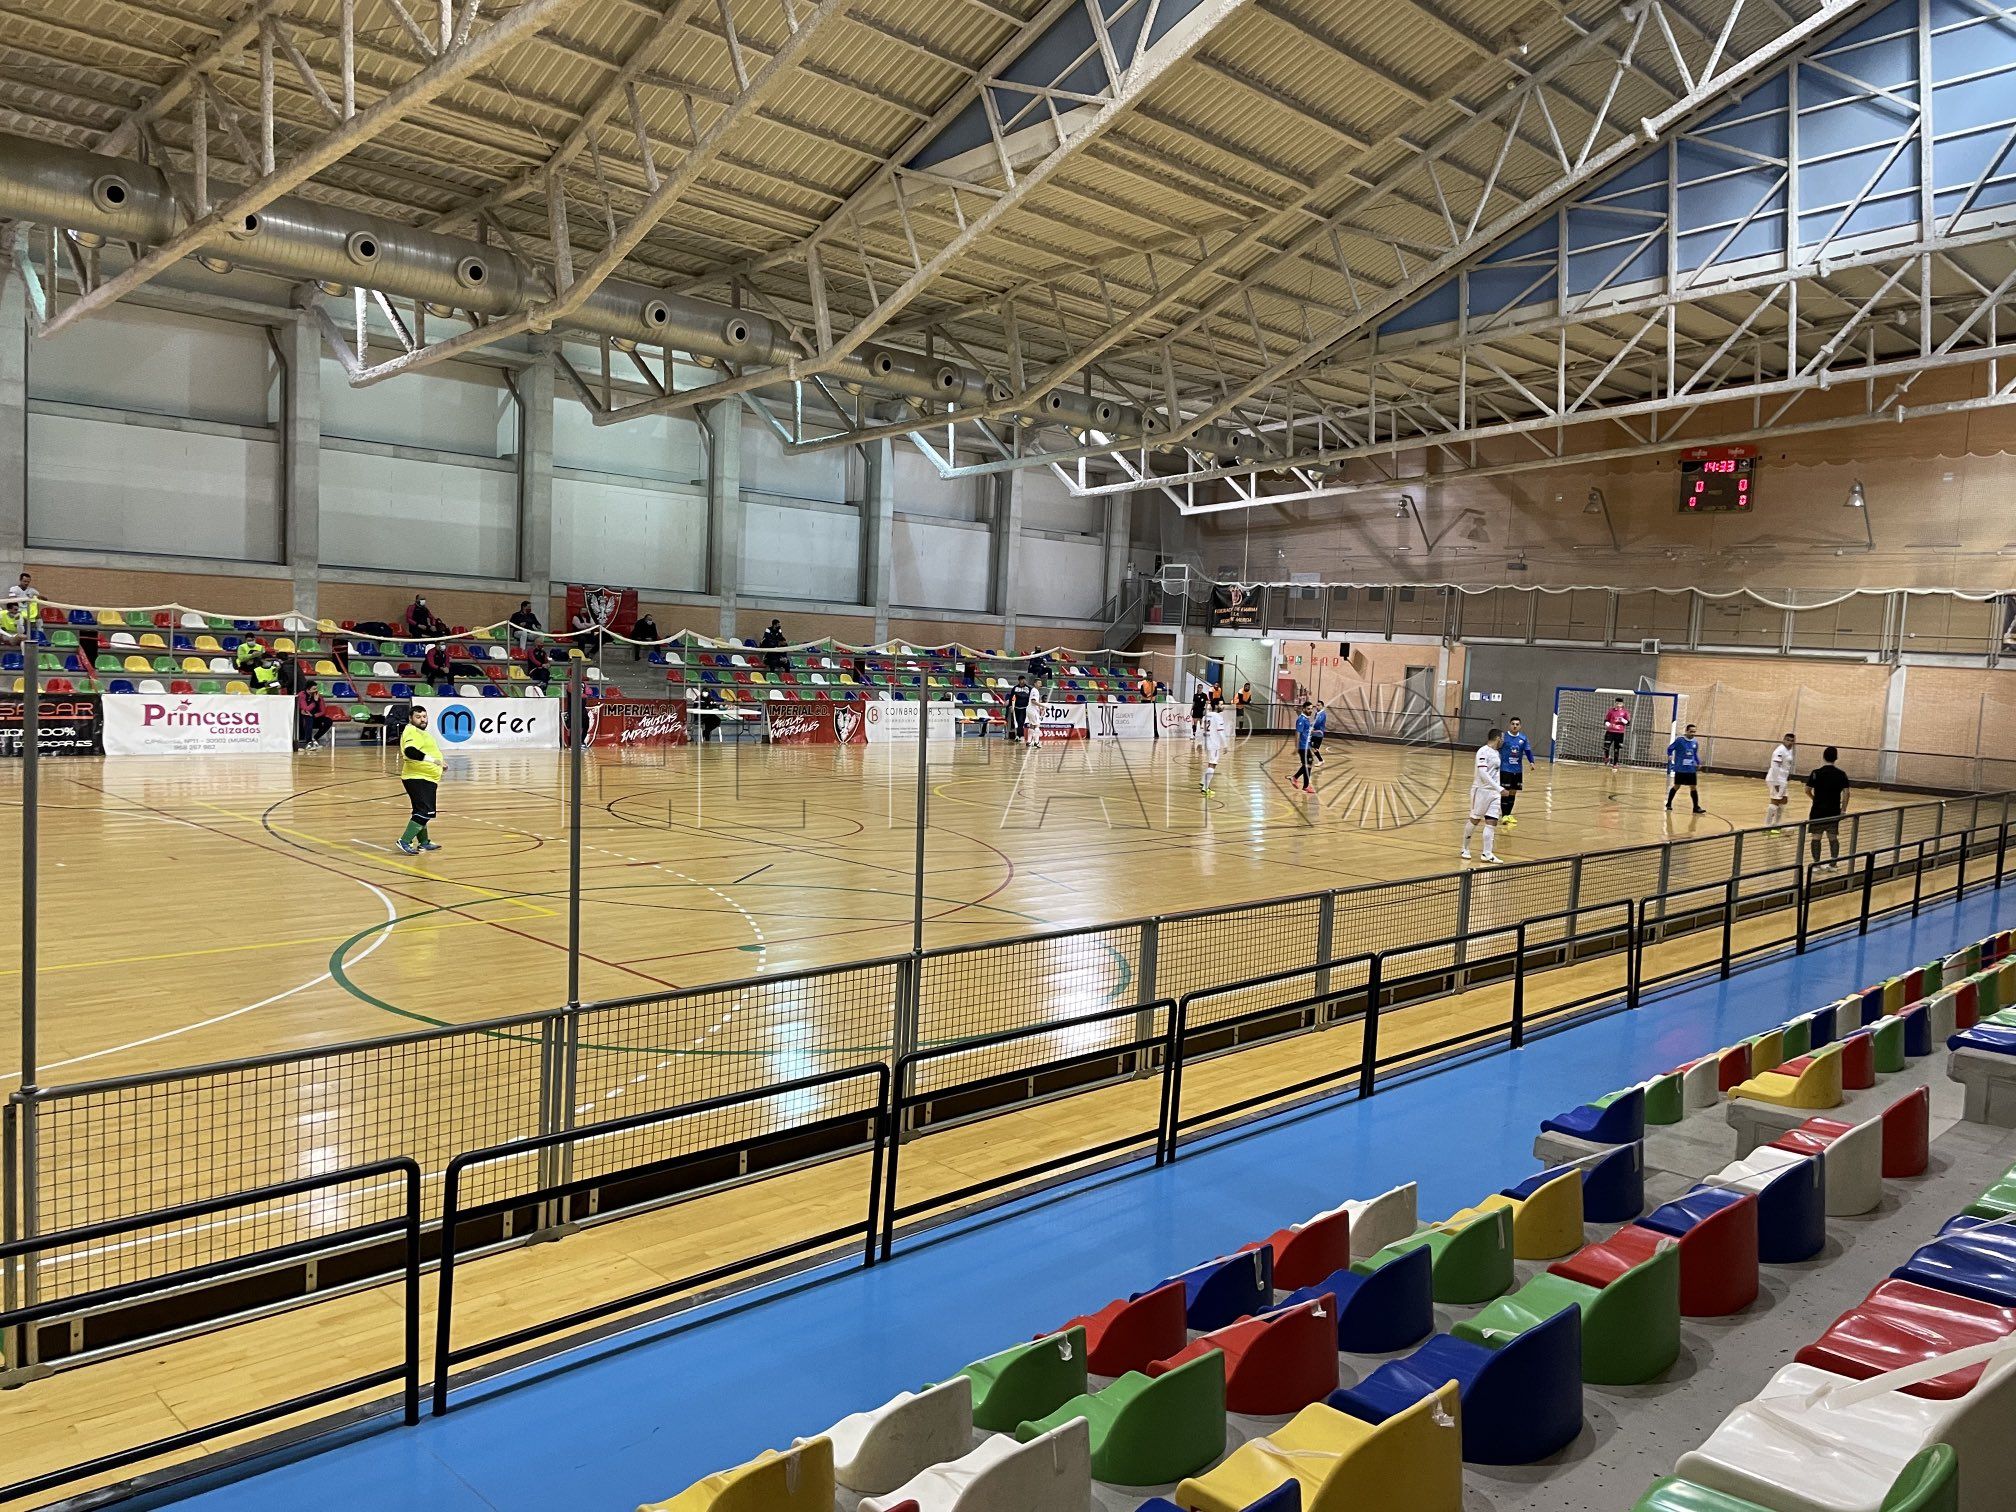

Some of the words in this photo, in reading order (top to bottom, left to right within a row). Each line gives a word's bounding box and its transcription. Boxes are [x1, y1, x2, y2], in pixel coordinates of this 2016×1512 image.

[1704, 460, 1735, 473] 14:33
[1695, 481, 1704, 492] 0
[1738, 479, 1747, 491] 0
[1689, 496, 1696, 506] 0
[1739, 495, 1746, 505] 0
[141, 703, 260, 727] Princesa
[603, 704, 657, 717] IMPERIAL
[769, 704, 813, 716] IMPERIAL
[209, 726, 261, 734] Calzados
[620, 721, 682, 743] IMPERIALES
[770, 721, 819, 739] IMPERIALES
